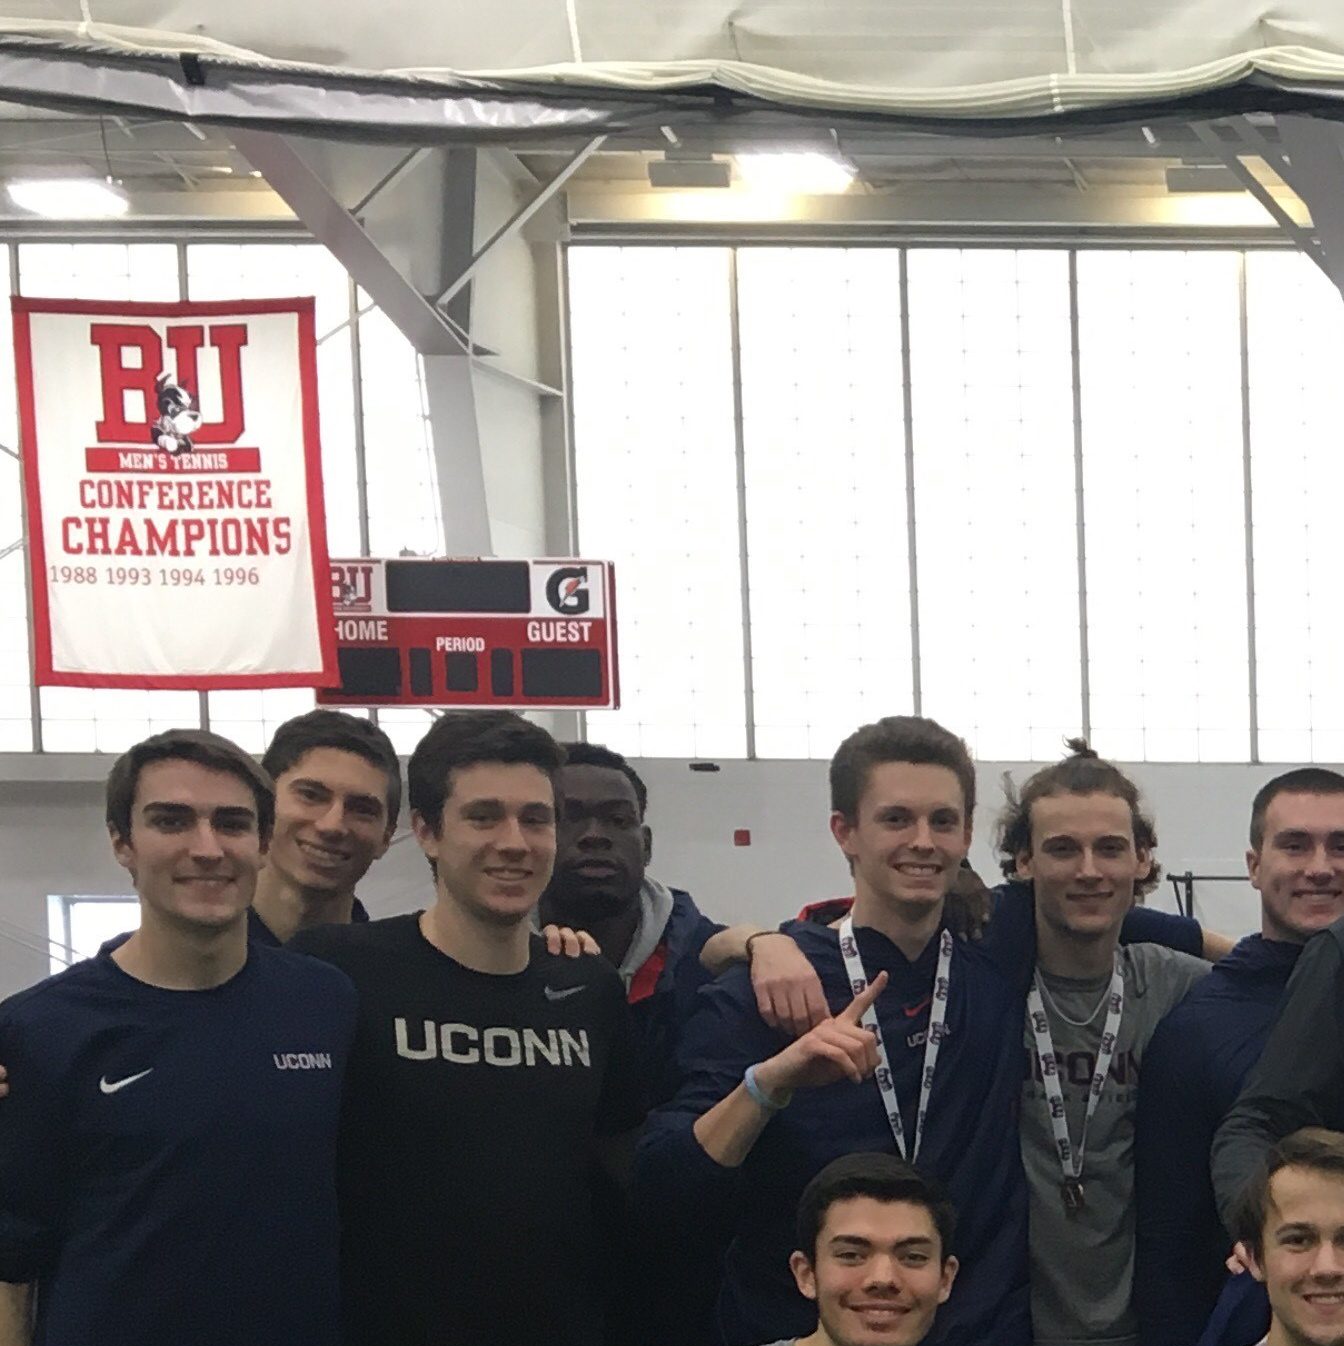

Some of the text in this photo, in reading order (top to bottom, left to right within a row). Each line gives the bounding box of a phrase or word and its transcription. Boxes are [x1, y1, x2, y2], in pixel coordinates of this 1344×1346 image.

[90, 323, 248, 444] BU
[119, 452, 228, 471] MEN'S TENNIS
[80, 480, 272, 510] CONFERENCE
[62, 516, 292, 557] CHAMPIONS
[51, 565, 260, 586] 1988 1993 1994 1996
[527, 622, 592, 642] GUEST
[436, 637, 485, 652] PERIOD
[395, 1017, 591, 1068] UCONN
[273, 1052, 332, 1070] UCONN
